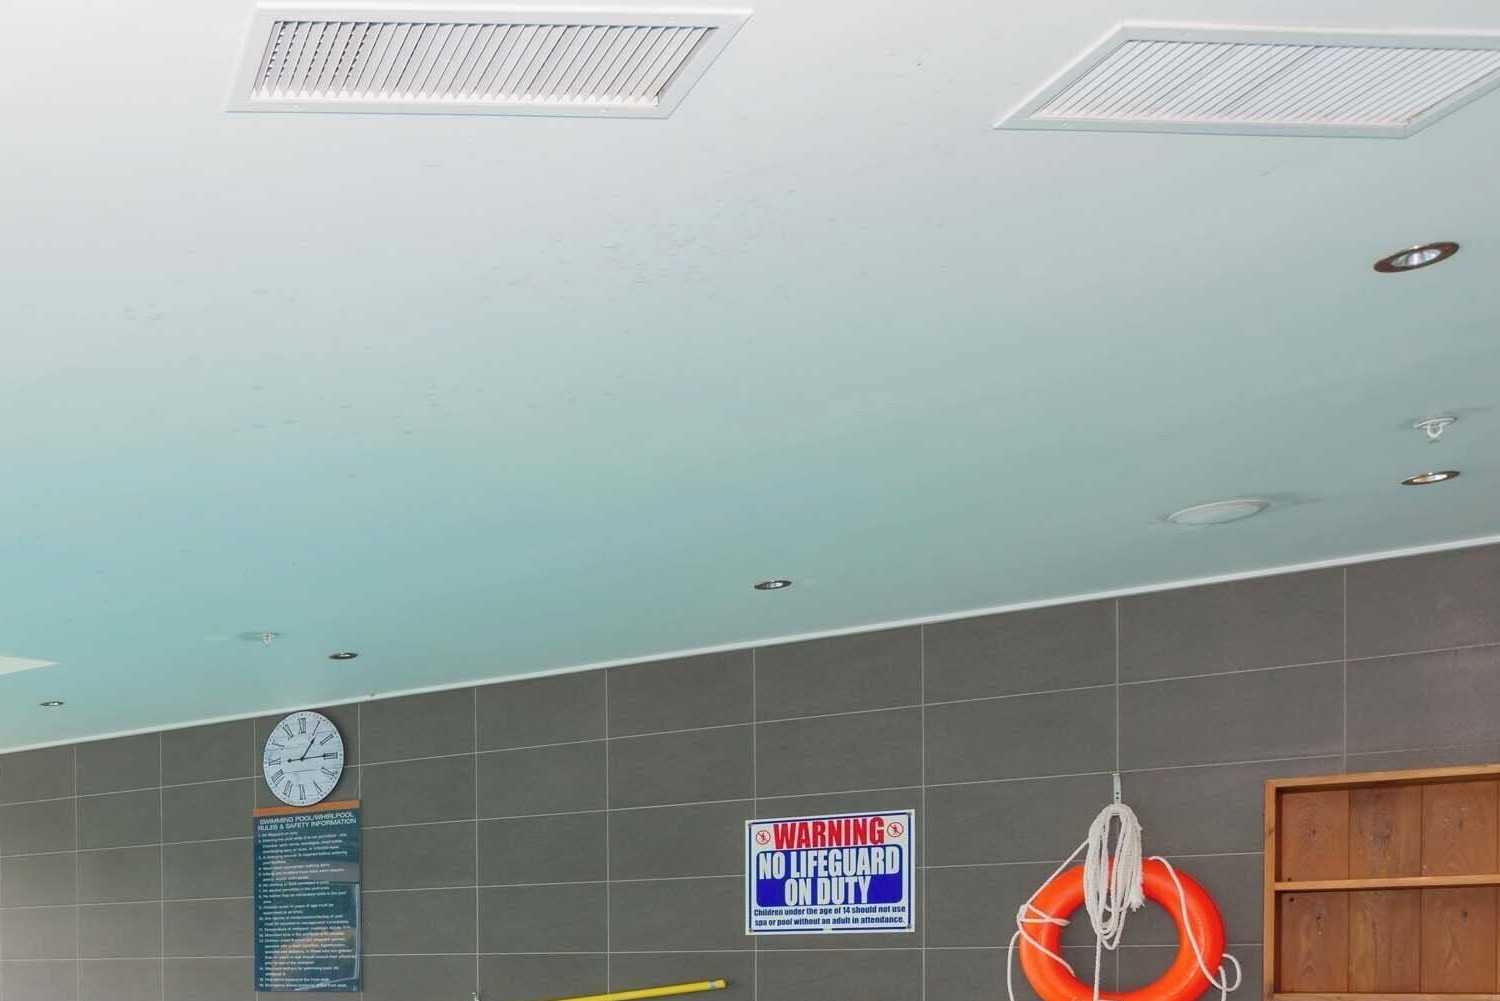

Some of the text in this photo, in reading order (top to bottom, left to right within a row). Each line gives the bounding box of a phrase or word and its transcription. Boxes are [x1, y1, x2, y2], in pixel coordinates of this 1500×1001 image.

[257, 822, 278, 831] RULES
[285, 822, 310, 830] SAFETY
[311, 817, 357, 827] INFORMATION
[260, 816, 293, 825] SWIMMING
[773, 816, 885, 850] WARNING
[758, 846, 900, 880] NO LIFEGUARD
[784, 875, 872, 906] ON DUTY
[819, 908, 832, 916] age
[842, 906, 850, 914] 14
[852, 906, 877, 914] should
[777, 918, 792, 926] pool
